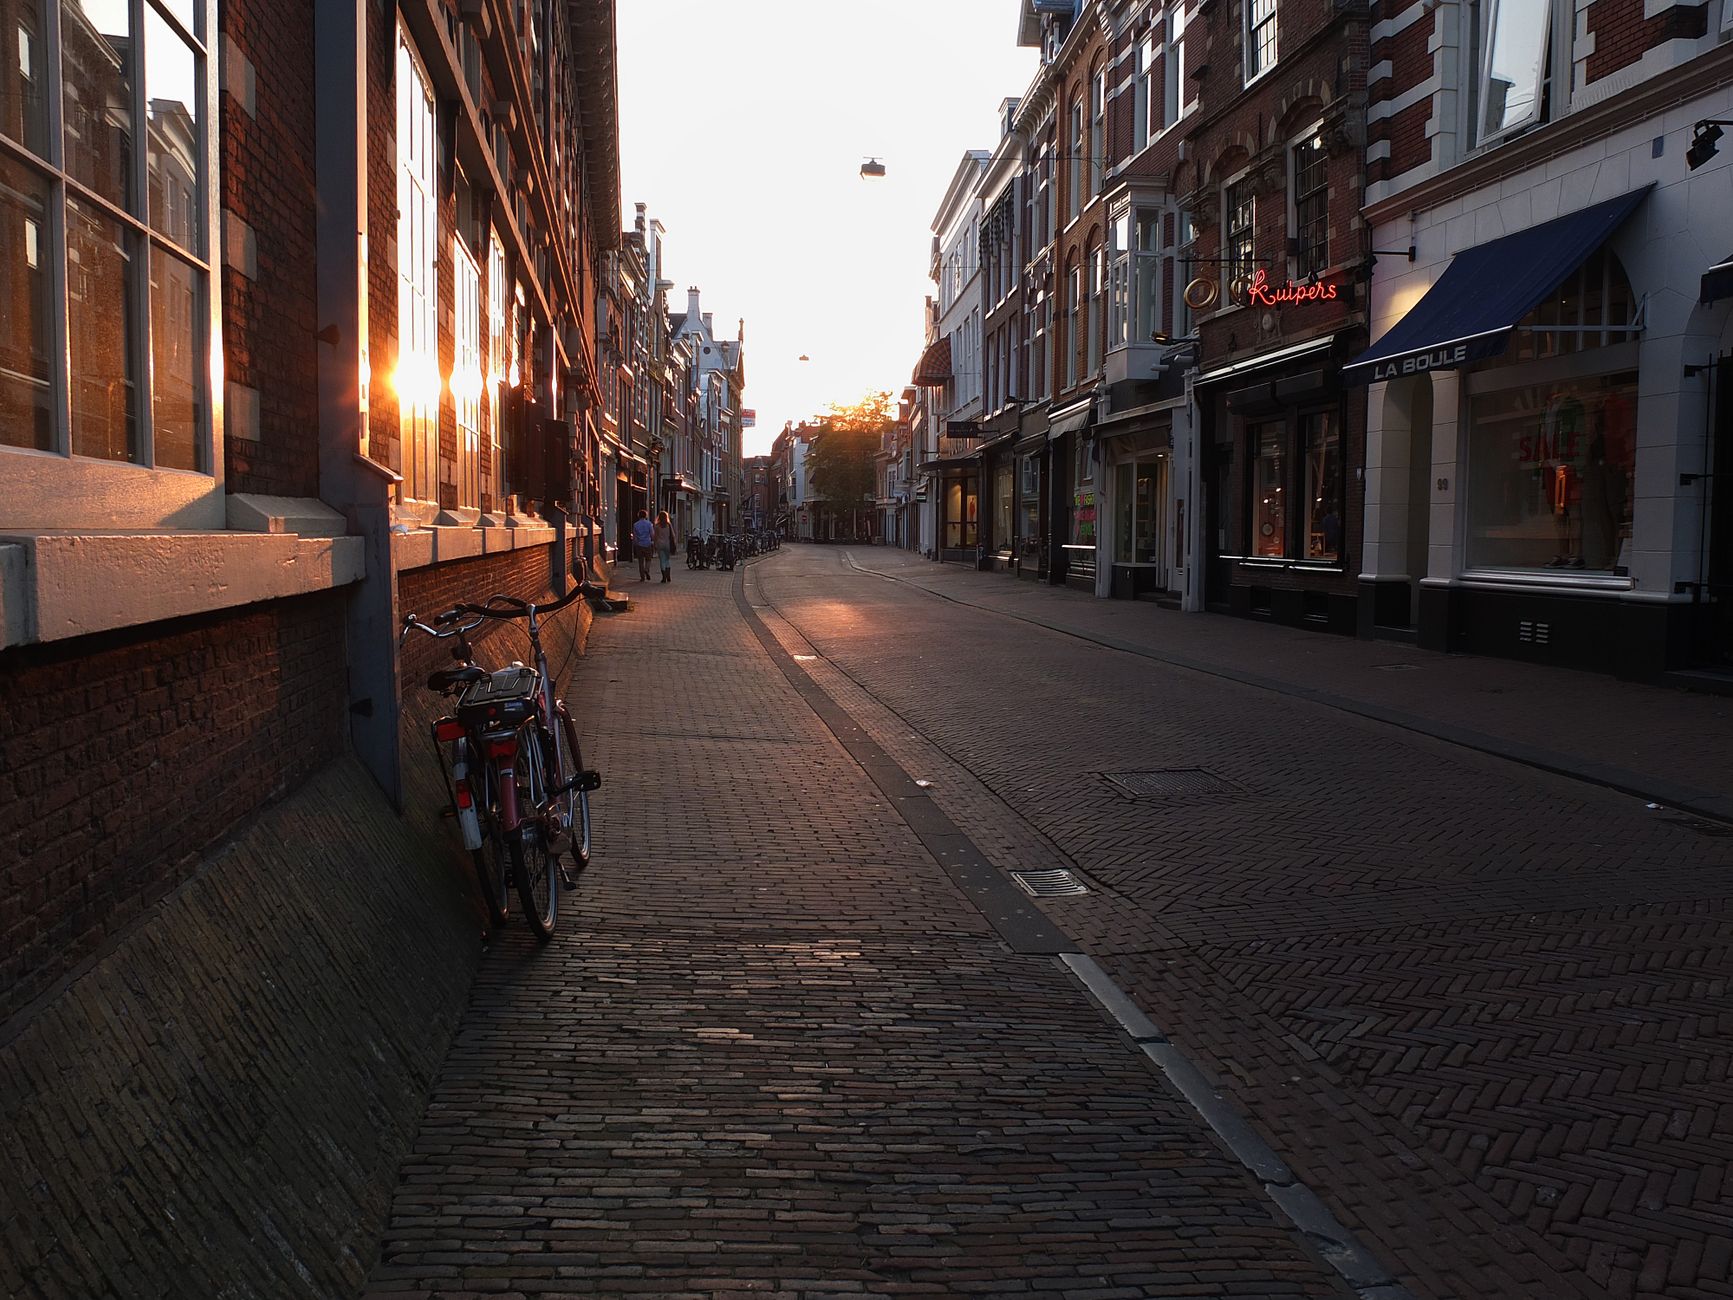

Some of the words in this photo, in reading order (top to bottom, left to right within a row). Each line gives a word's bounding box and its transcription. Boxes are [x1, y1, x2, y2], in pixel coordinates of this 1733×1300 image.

[1248, 269, 1337, 305] Kuipers
[1374, 362, 1398, 380] LA
[1402, 345, 1467, 374] BOULE
[1519, 432, 1581, 461] SALE
